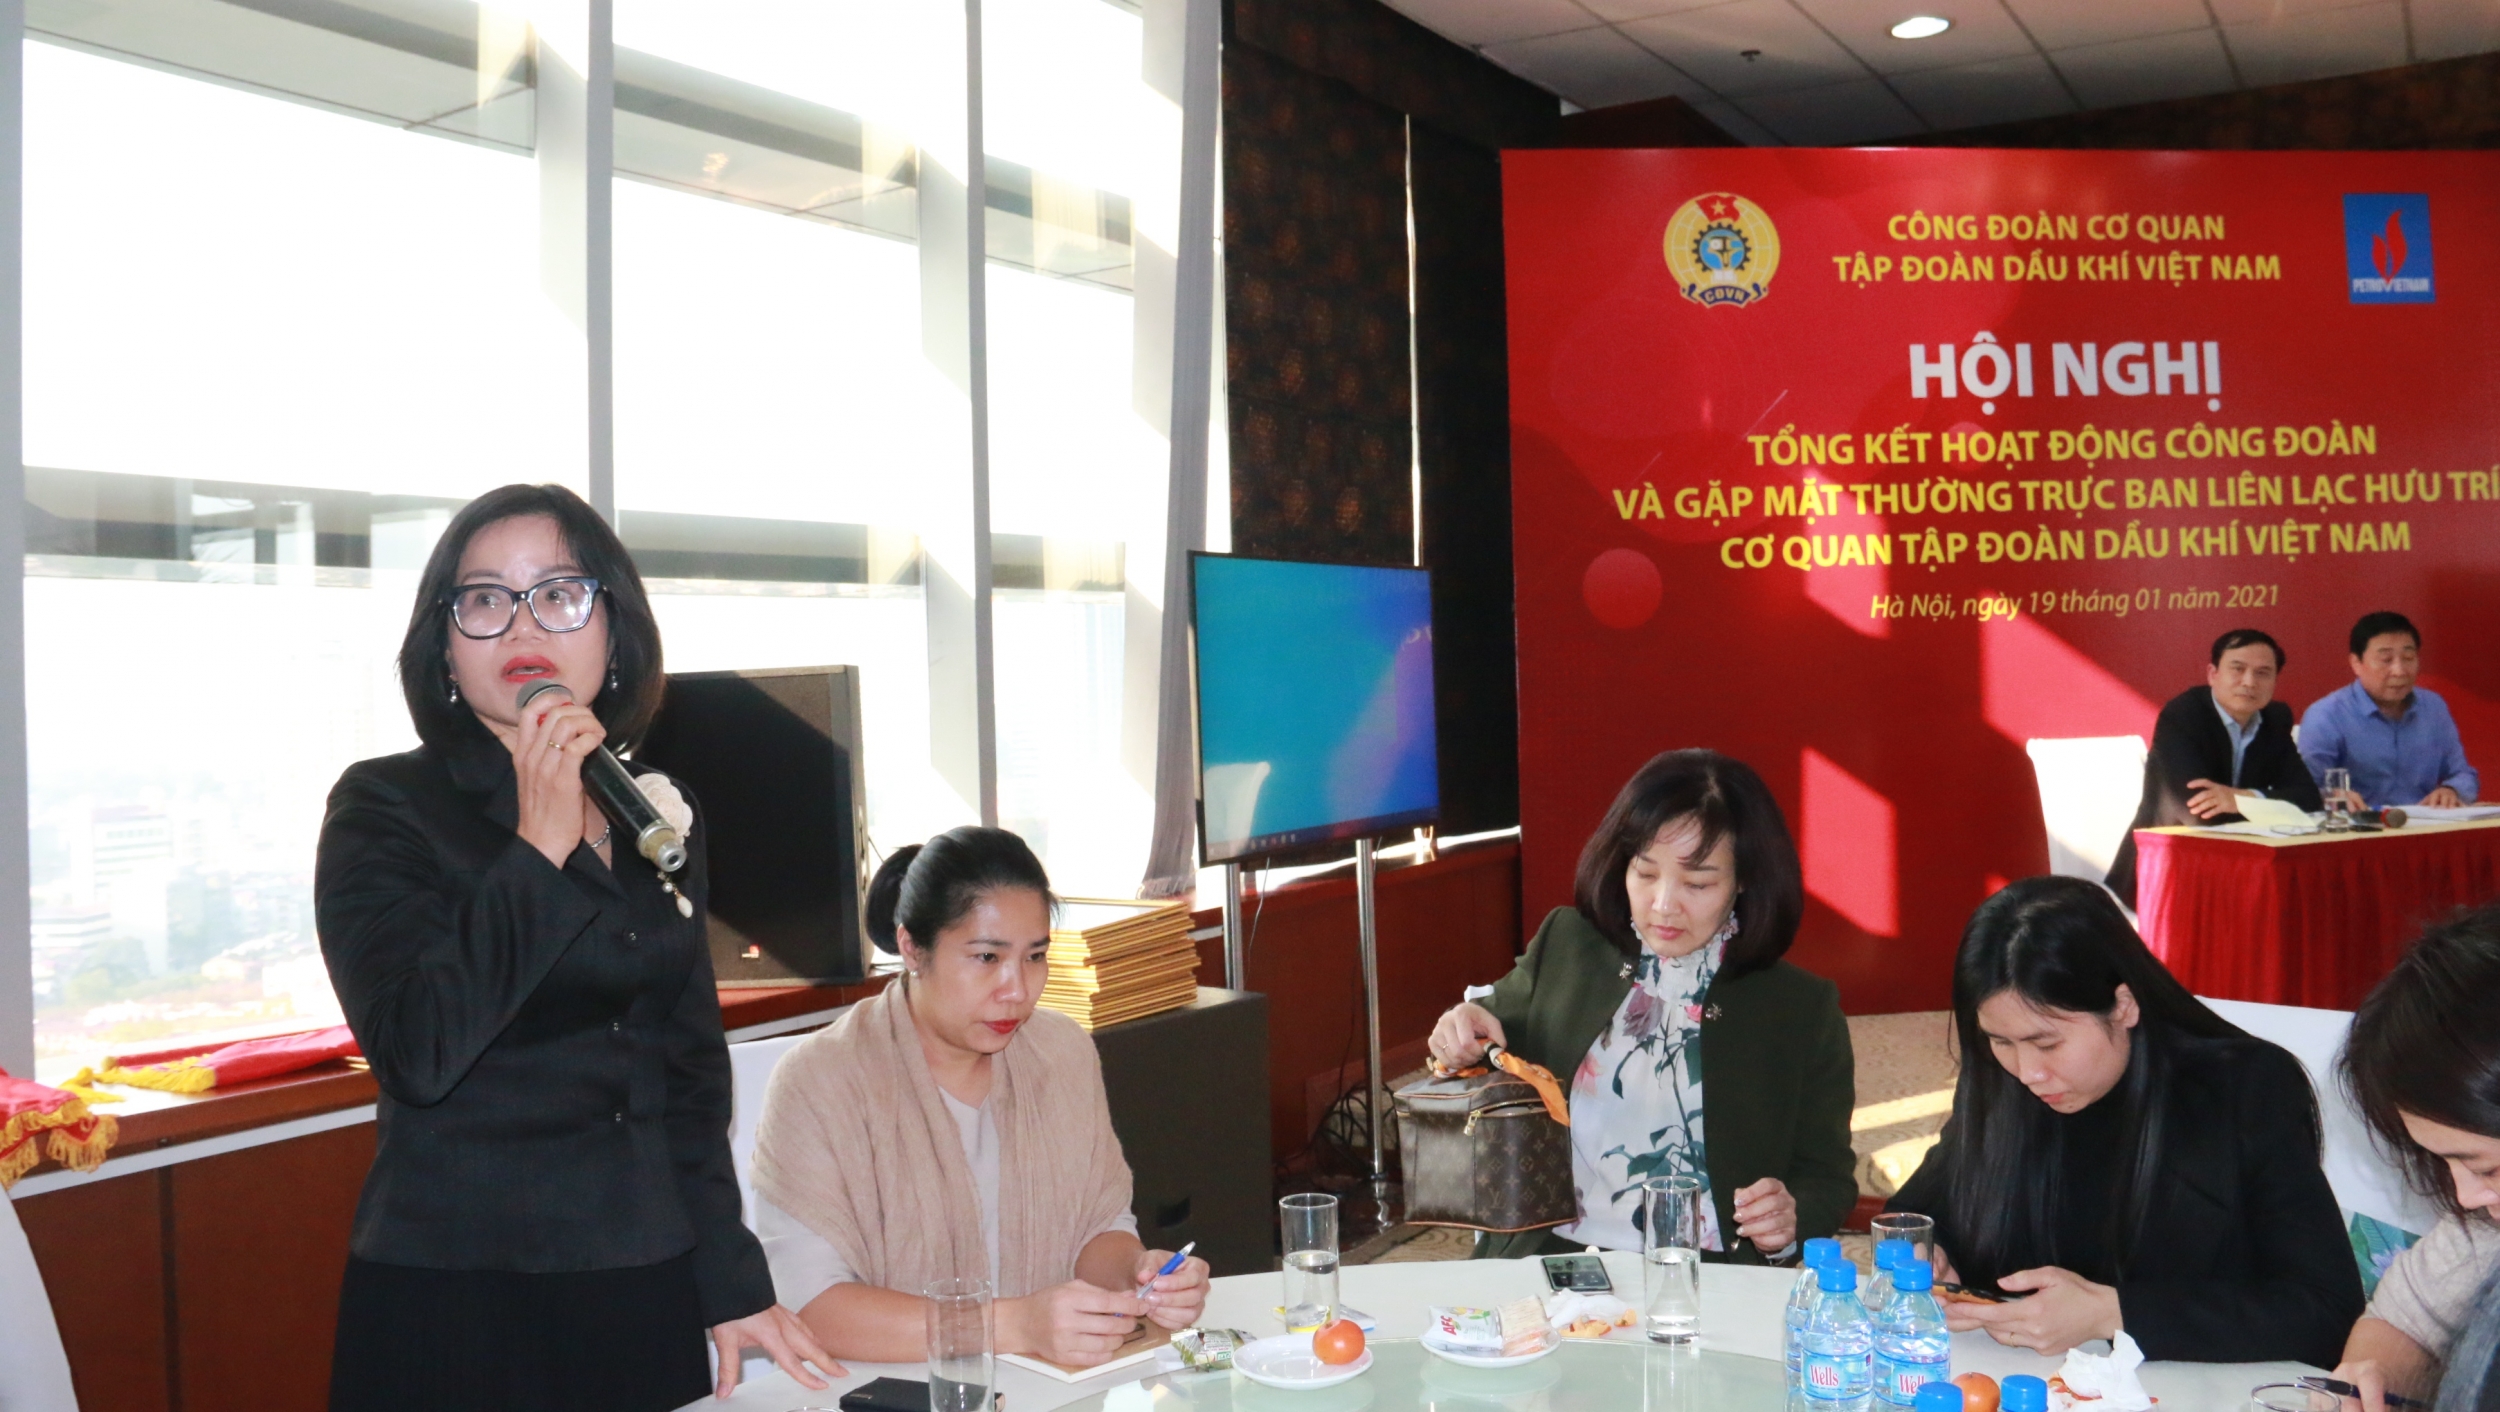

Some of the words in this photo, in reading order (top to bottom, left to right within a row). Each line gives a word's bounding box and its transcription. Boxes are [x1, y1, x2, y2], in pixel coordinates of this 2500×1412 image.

[1888, 209, 1978, 241] CÔNG
[1986, 209, 2078, 241] ĐOÀN
[2087, 213, 2129, 241] CƠ
[2136, 214, 2225, 244] QUAN
[1832, 251, 1893, 289] TẬP
[1900, 250, 1994, 282] ĐOÀN
[2003, 248, 2068, 282] DẦU
[2077, 250, 2129, 281] KHÍ
[2136, 250, 2202, 287] VIỆT
[2210, 255, 2282, 281] NAM
[1909, 331, 2034, 415] HỘI
[2051, 341, 2222, 412] NGHỊ
[1747, 423, 1855, 467] TỔNG
[1864, 423, 1932, 464] KẾT
[1941, 430, 2040, 470] HOẠT
[2047, 424, 2157, 468] ĐỘNG
[2165, 422, 2266, 459] CÔNG
[2273, 419, 2377, 457] ĐOÀN
[1613, 482, 1665, 520] VÀ
[1674, 480, 1754, 527] GẶP
[1764, 478, 1843, 525] MẶT
[1849, 476, 2013, 515] THƯỜNG
[2019, 475, 2117, 518] TRỰC
[2125, 477, 2199, 509] BAN
[2208, 470, 2283, 507] LIÊN
[2292, 474, 2356, 513] LẠC
[2365, 469, 2442, 504] HƯU
[2447, 464, 2500, 501] TRÍ
[1721, 533, 1775, 569] CƠ
[1782, 534, 1892, 572] QUAN
[1899, 527, 1968, 572] TẬP
[1976, 524, 2085, 563] ĐOÀN
[2095, 520, 2169, 560] DẦU
[2180, 519, 2239, 557] KHÍ
[2245, 518, 2321, 562] VIỆT
[2330, 522, 2411, 553] NAM
[1870, 594, 1904, 619] Hà
[1911, 593, 1956, 622] Nội,
[1963, 592, 2022, 622] ngày
[2030, 591, 2056, 614] 19
[2061, 588, 2130, 617] tháng
[2135, 588, 2161, 610] 01
[2168, 587, 2221, 609] năm
[2226, 585, 2279, 607] 2021
[1440, 1315, 1457, 1336] AFC
[1810, 1364, 1839, 1387] Wells
